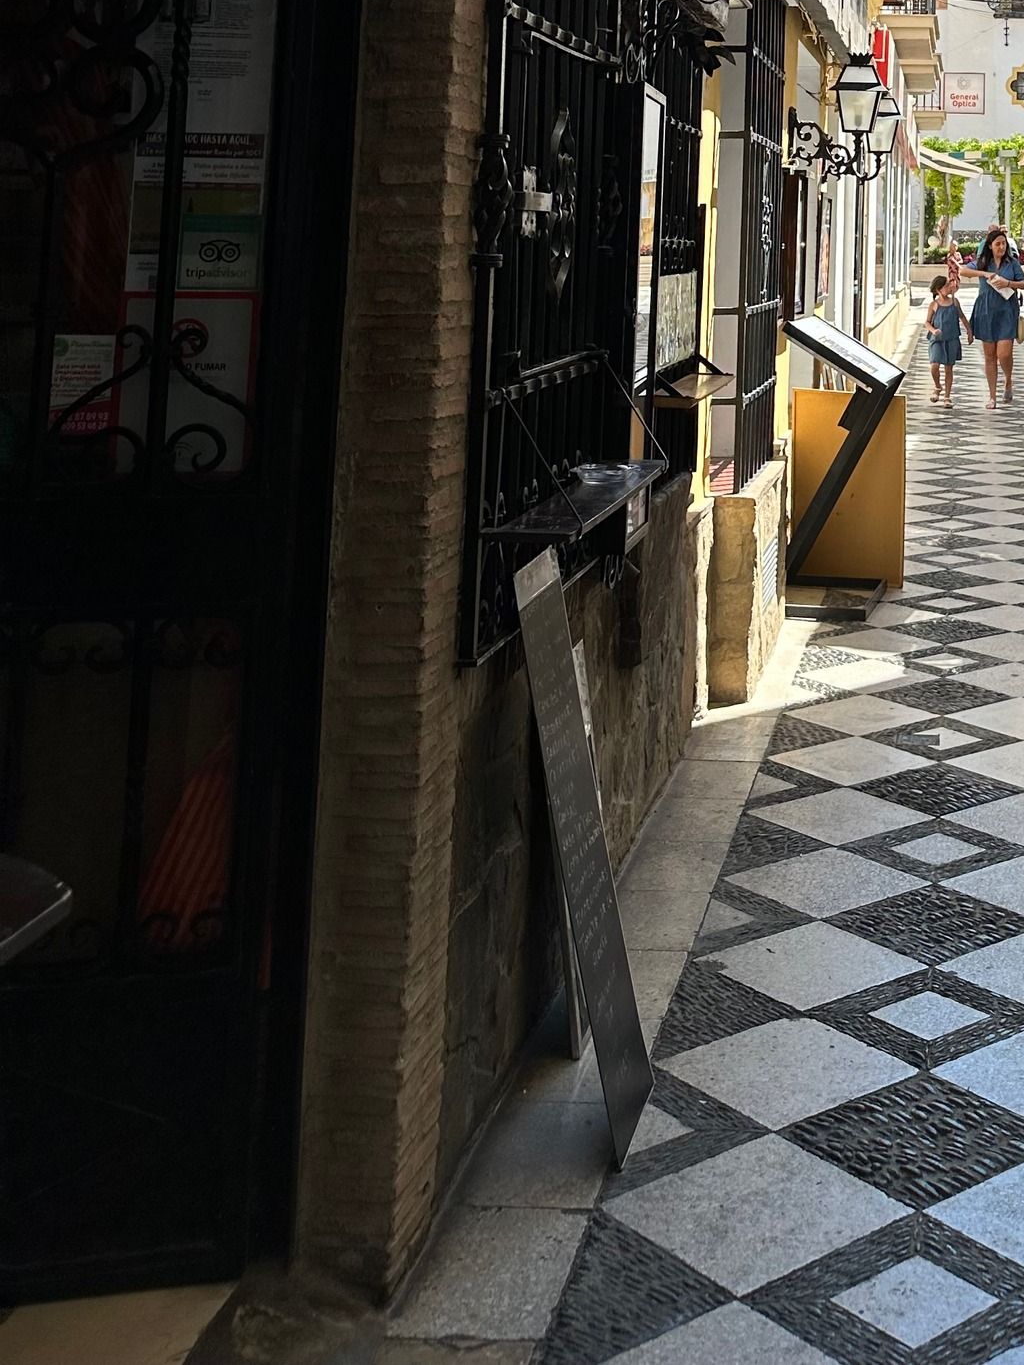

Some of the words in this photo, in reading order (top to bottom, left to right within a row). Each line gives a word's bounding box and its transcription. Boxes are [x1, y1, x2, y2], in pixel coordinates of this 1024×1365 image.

[950, 93, 979, 101] General
[200, 134, 227, 145] HASTA
[186, 267, 247, 280] tripadvisor
[195, 362, 226, 371] FUMAR
